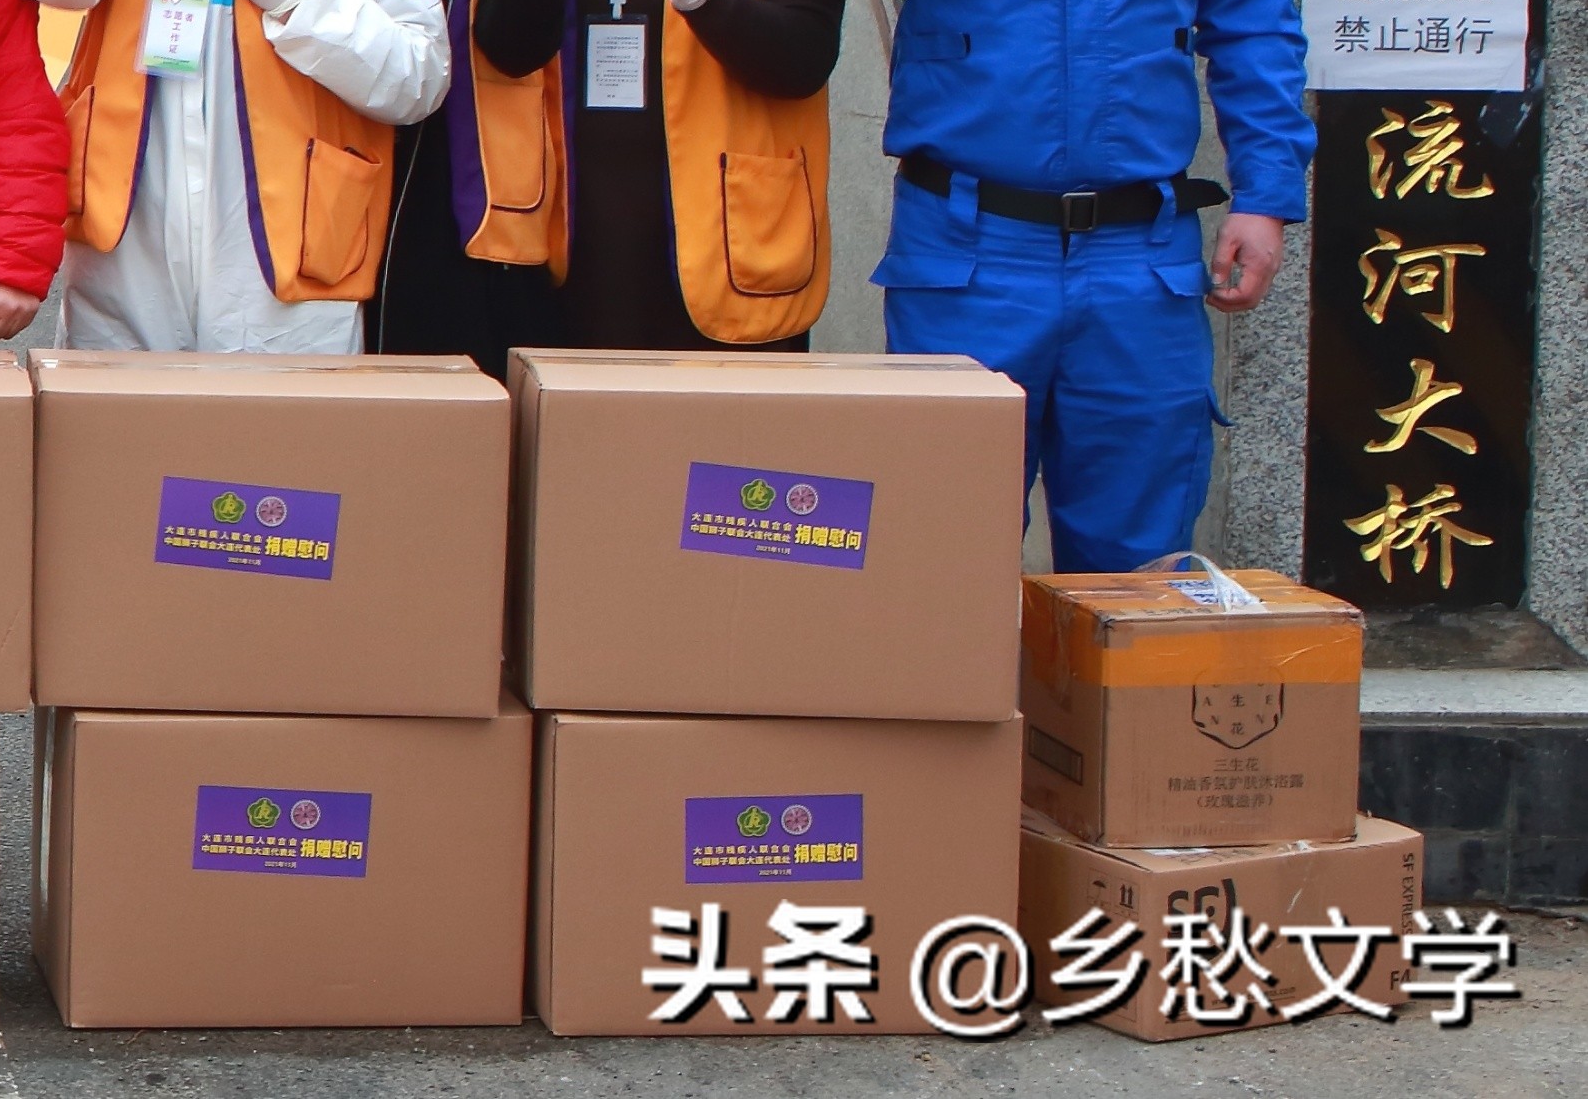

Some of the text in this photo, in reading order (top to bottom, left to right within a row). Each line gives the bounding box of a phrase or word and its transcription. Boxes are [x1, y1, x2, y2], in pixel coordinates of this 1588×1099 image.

[1334, 15, 1495, 56] 禁止通行
[1343, 99, 1495, 589] 流河大桥
[264, 535, 330, 561] 捐赠慰问
[794, 523, 863, 551] 捐赠慰问
[1213, 758, 1260, 772] 三生花
[299, 838, 363, 860] 捐赠慰问
[793, 842, 858, 864] 捐赠慰问
[1402, 851, 1415, 873] SF
